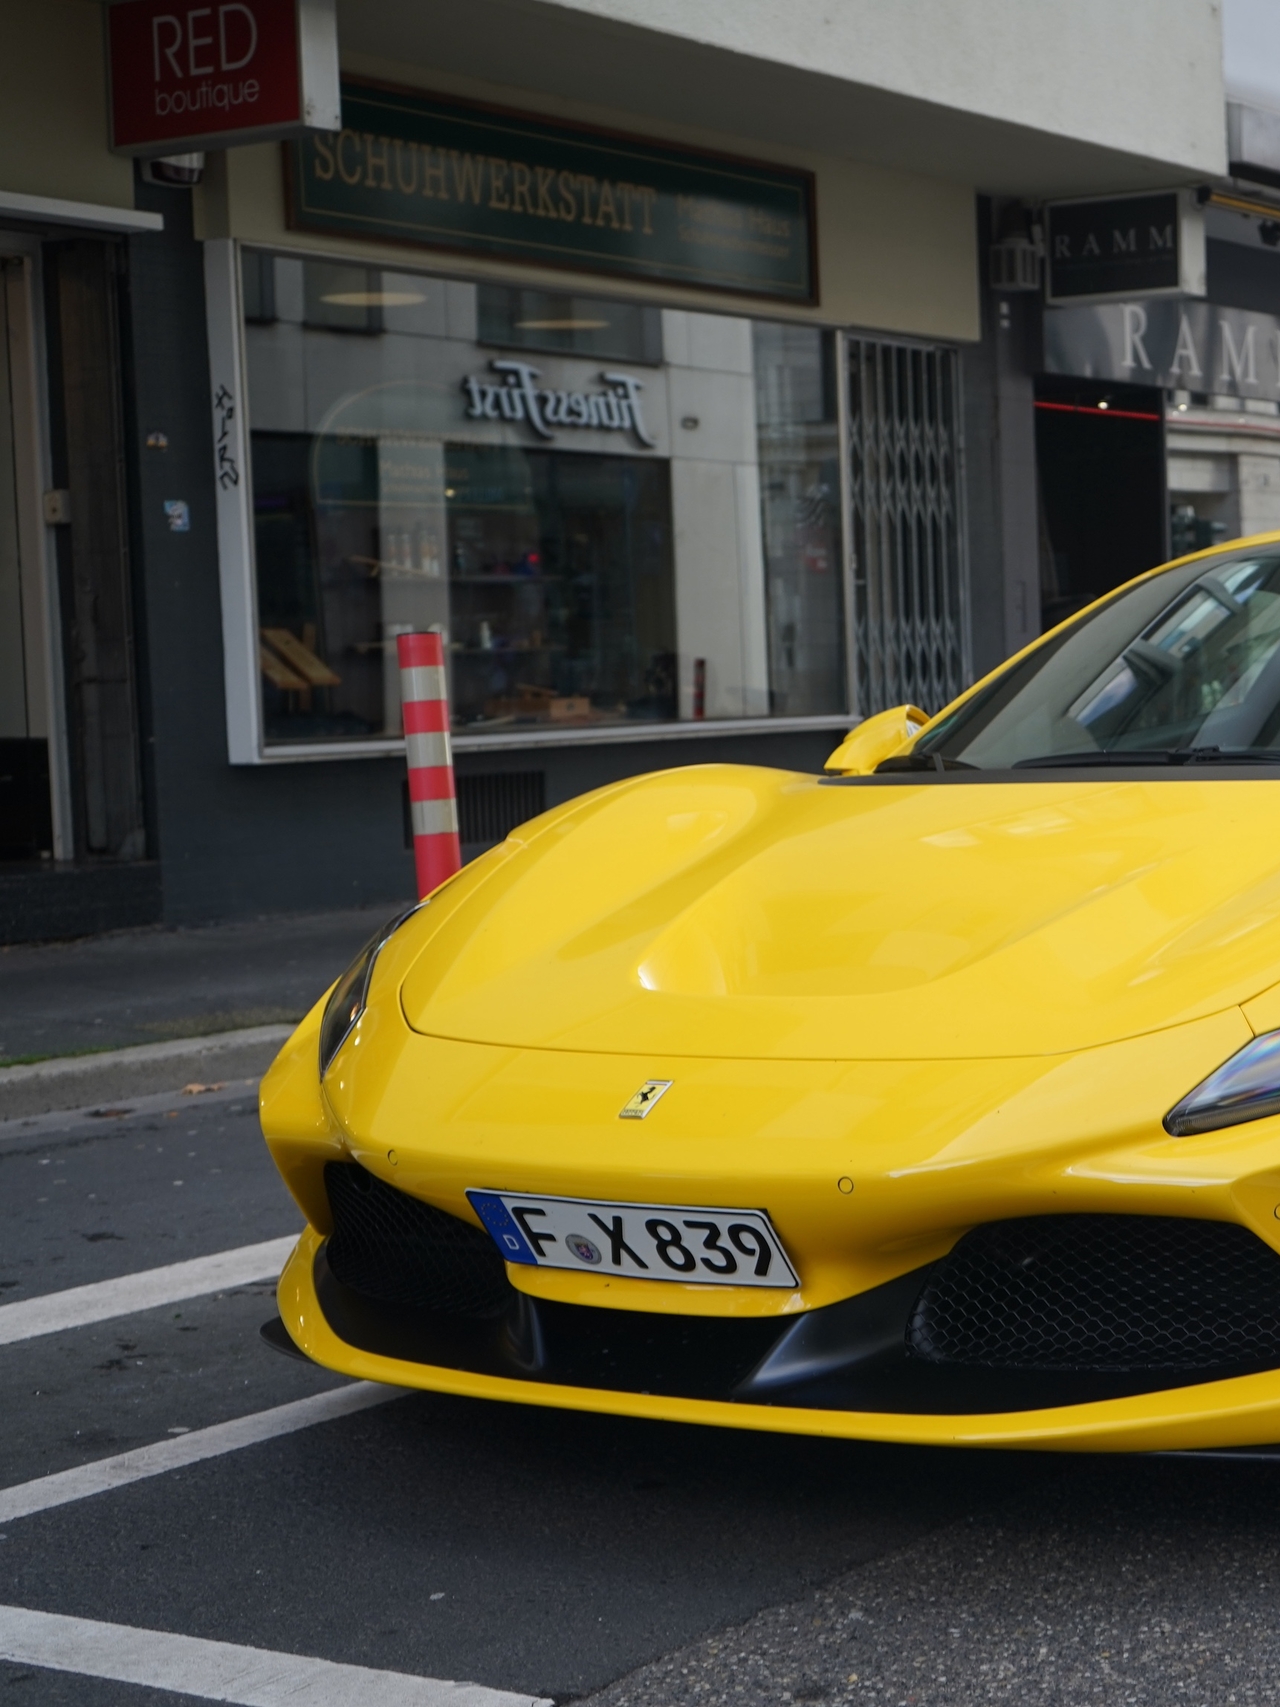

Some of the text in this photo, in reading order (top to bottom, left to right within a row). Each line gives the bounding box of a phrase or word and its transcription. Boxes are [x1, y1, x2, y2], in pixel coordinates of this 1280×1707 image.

[152, 3, 258, 81] RED
[154, 78, 260, 115] boutique
[314, 130, 656, 234] SCHUHWERKSTATT
[1054, 223, 1174, 259] RAMM
[503, 1234, 520, 1250] D
[511, 1206, 773, 1277] F X 839
